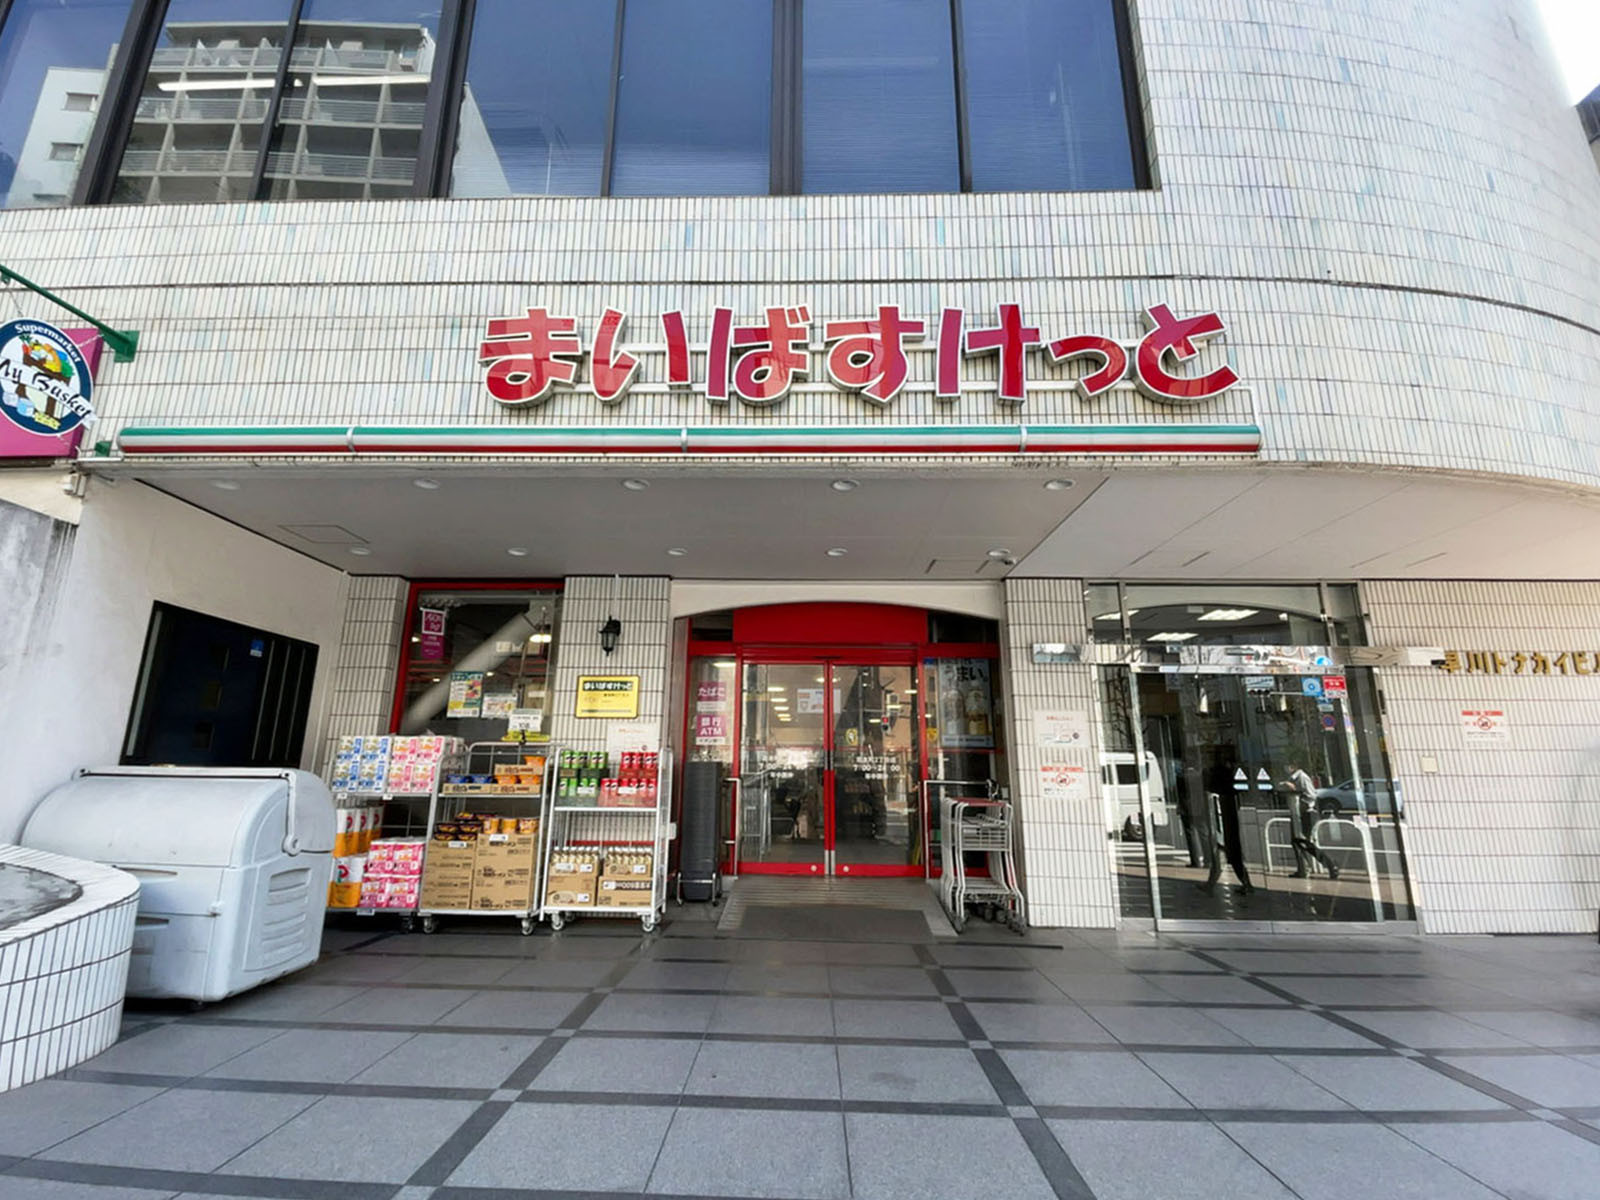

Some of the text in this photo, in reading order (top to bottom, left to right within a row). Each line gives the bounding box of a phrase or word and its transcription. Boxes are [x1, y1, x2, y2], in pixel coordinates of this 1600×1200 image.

[14, 323, 81, 362] Supermarket
[479, 302, 1240, 406] まいばすけっと
[32, 371, 92, 419] Basket
[698, 687, 725, 697] たばこ
[700, 727, 722, 736] ATM
[701, 716, 721, 727] 銀行
